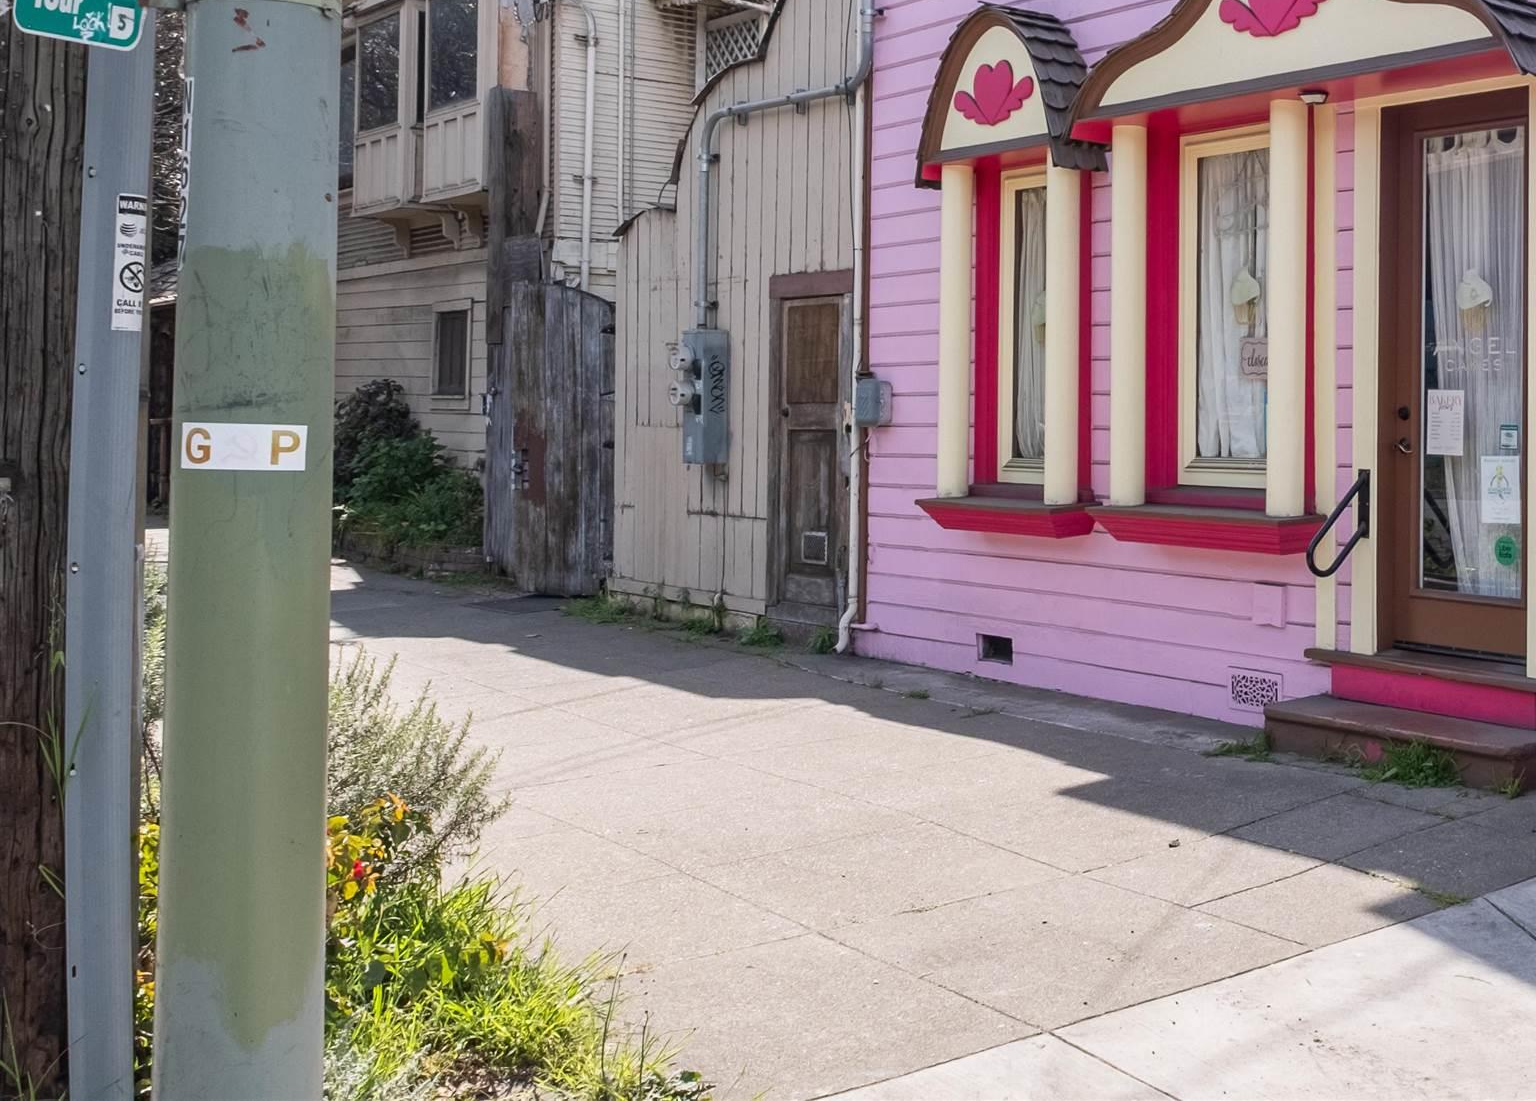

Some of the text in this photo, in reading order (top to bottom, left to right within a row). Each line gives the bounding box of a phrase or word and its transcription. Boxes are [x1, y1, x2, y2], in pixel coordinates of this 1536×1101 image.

[116, 299, 136, 307] CALL
[185, 427, 301, 466] G P
